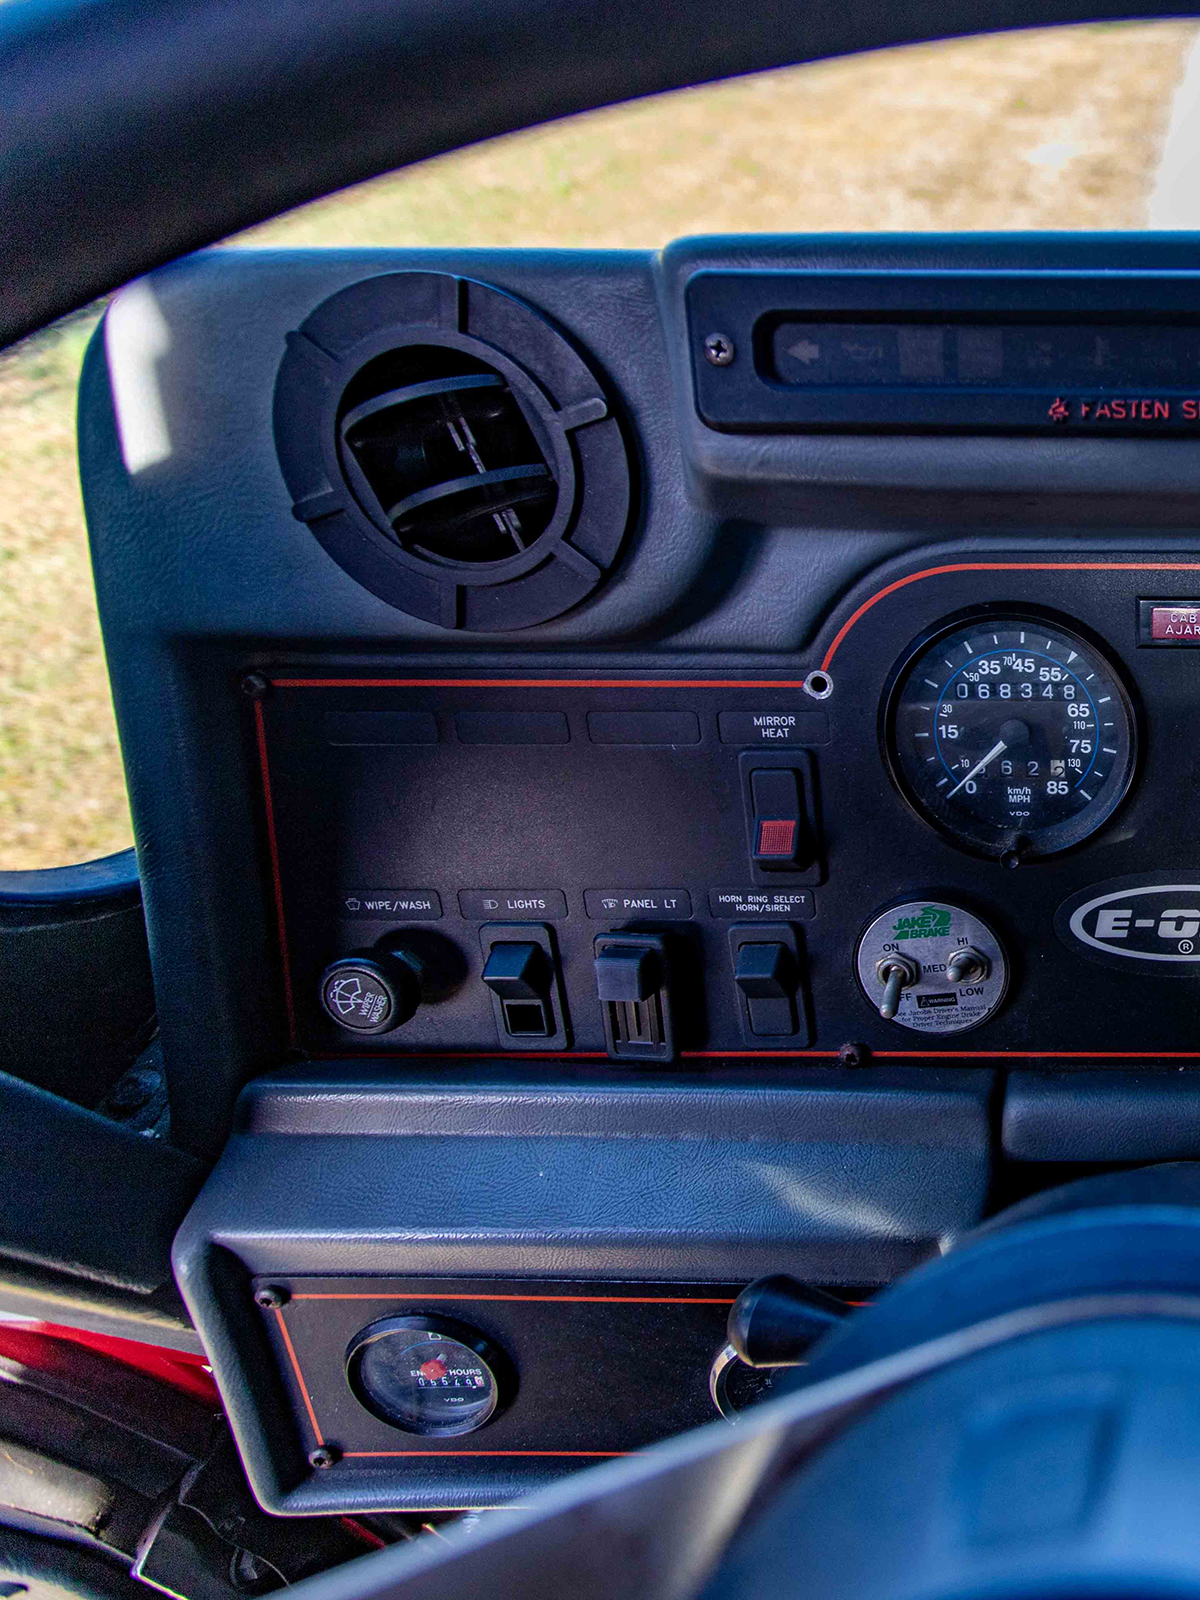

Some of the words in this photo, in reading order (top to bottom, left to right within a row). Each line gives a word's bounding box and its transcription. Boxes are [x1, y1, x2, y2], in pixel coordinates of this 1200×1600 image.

[1081, 401, 1170, 419] FASTEN
[1170, 614, 1197, 623] CAB
[1166, 625, 1200, 635] AJAR
[1003, 657, 1012, 665] 70
[1012, 659, 1035, 672] 45
[978, 661, 1000, 674] 35
[969, 673, 979, 681] 50
[1039, 668, 1061, 681] 55
[943, 705, 952, 713] 30
[1067, 704, 1089, 717] 65
[753, 717, 796, 727] MIRROR
[1073, 721, 1085, 729] 110
[762, 728, 790, 738] HEAT
[939, 725, 958, 738] 15
[1070, 740, 1091, 753] 75
[1068, 759, 1080, 767] 130
[965, 780, 976, 793] 0
[1008, 786, 1031, 795] km/h
[1047, 781, 1068, 794] 85
[624, 899, 657, 908] PANEL
[665, 900, 676, 908] LT
[719, 895, 742, 903] HORN
[365, 901, 431, 911] WIPE/WASH
[507, 900, 546, 909] LIGHTS
[736, 904, 790, 913] HORN/SIREN
[893, 916, 932, 930] JAKE
[910, 927, 950, 939] BRAKE
[883, 944, 899, 952] ON
[923, 964, 946, 973] MED
[900, 993, 911, 1001] FF
[959, 987, 984, 997] LOW
[359, 992, 375, 1017] WIPER
[370, 994, 388, 1023] WASHER
